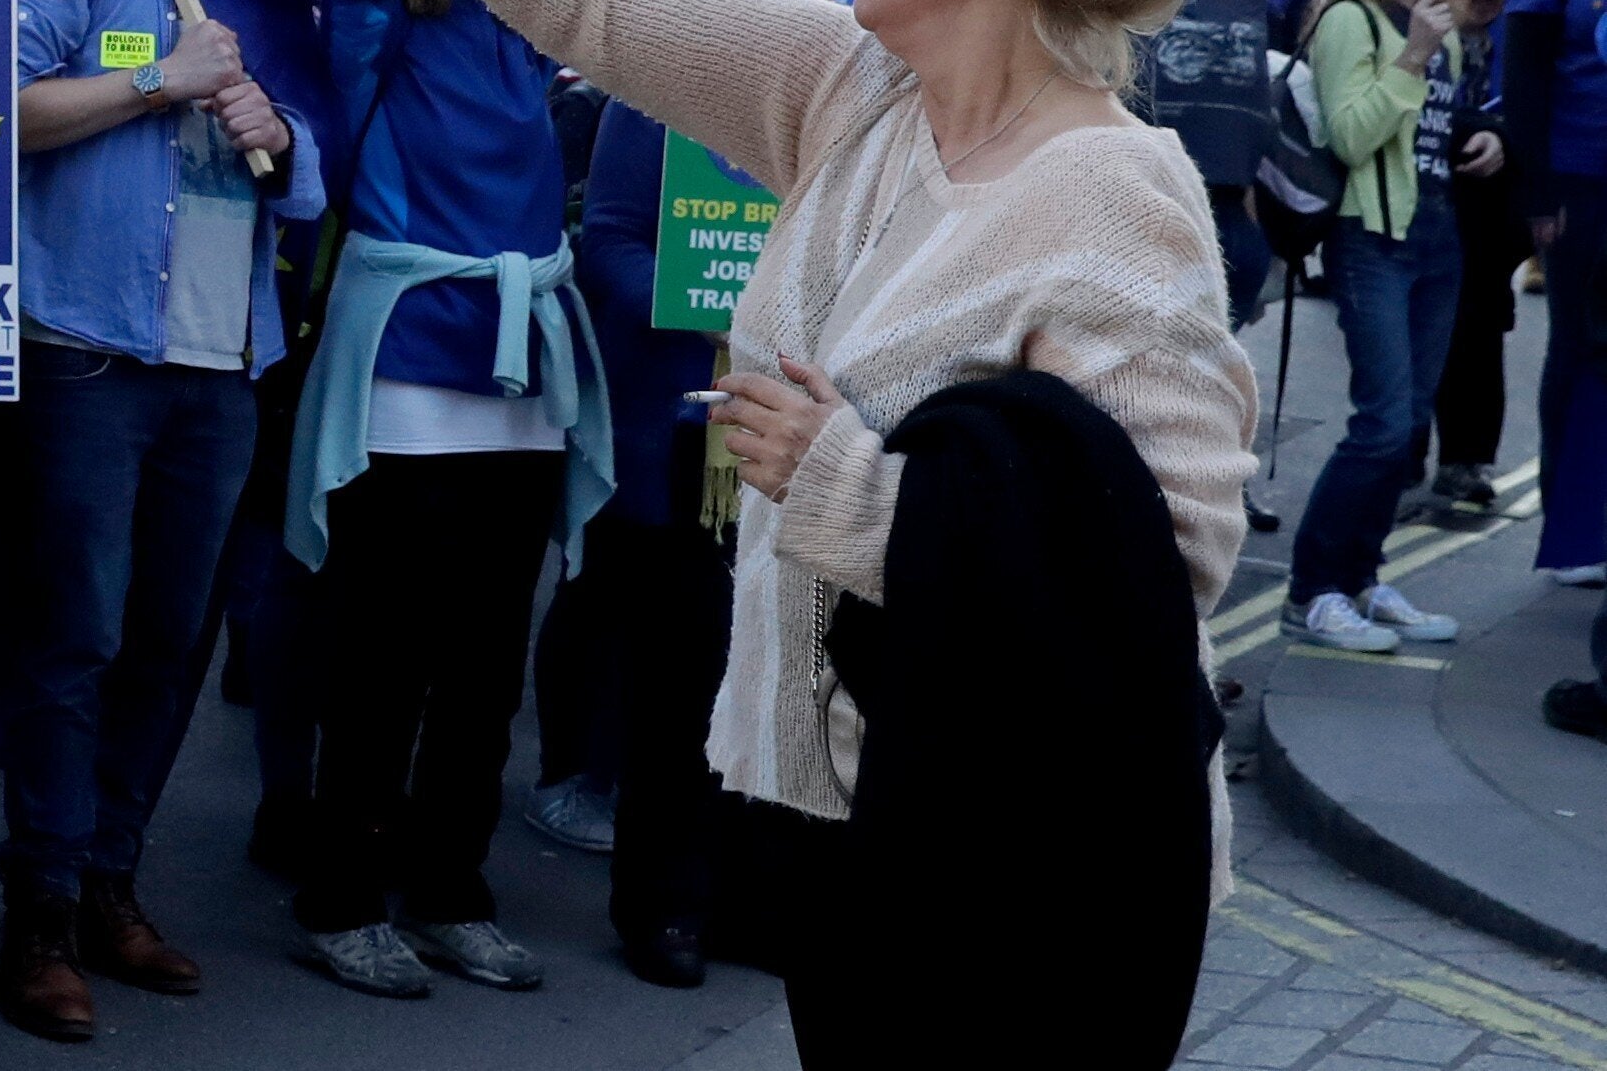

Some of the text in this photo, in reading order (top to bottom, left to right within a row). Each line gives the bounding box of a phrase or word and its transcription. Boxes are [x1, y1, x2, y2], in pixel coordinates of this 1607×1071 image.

[105, 43, 150, 53] TO BREXIT
[106, 34, 150, 45] BOLLOCKS
[672, 197, 737, 221] STOP
[689, 228, 769, 252] INVES
